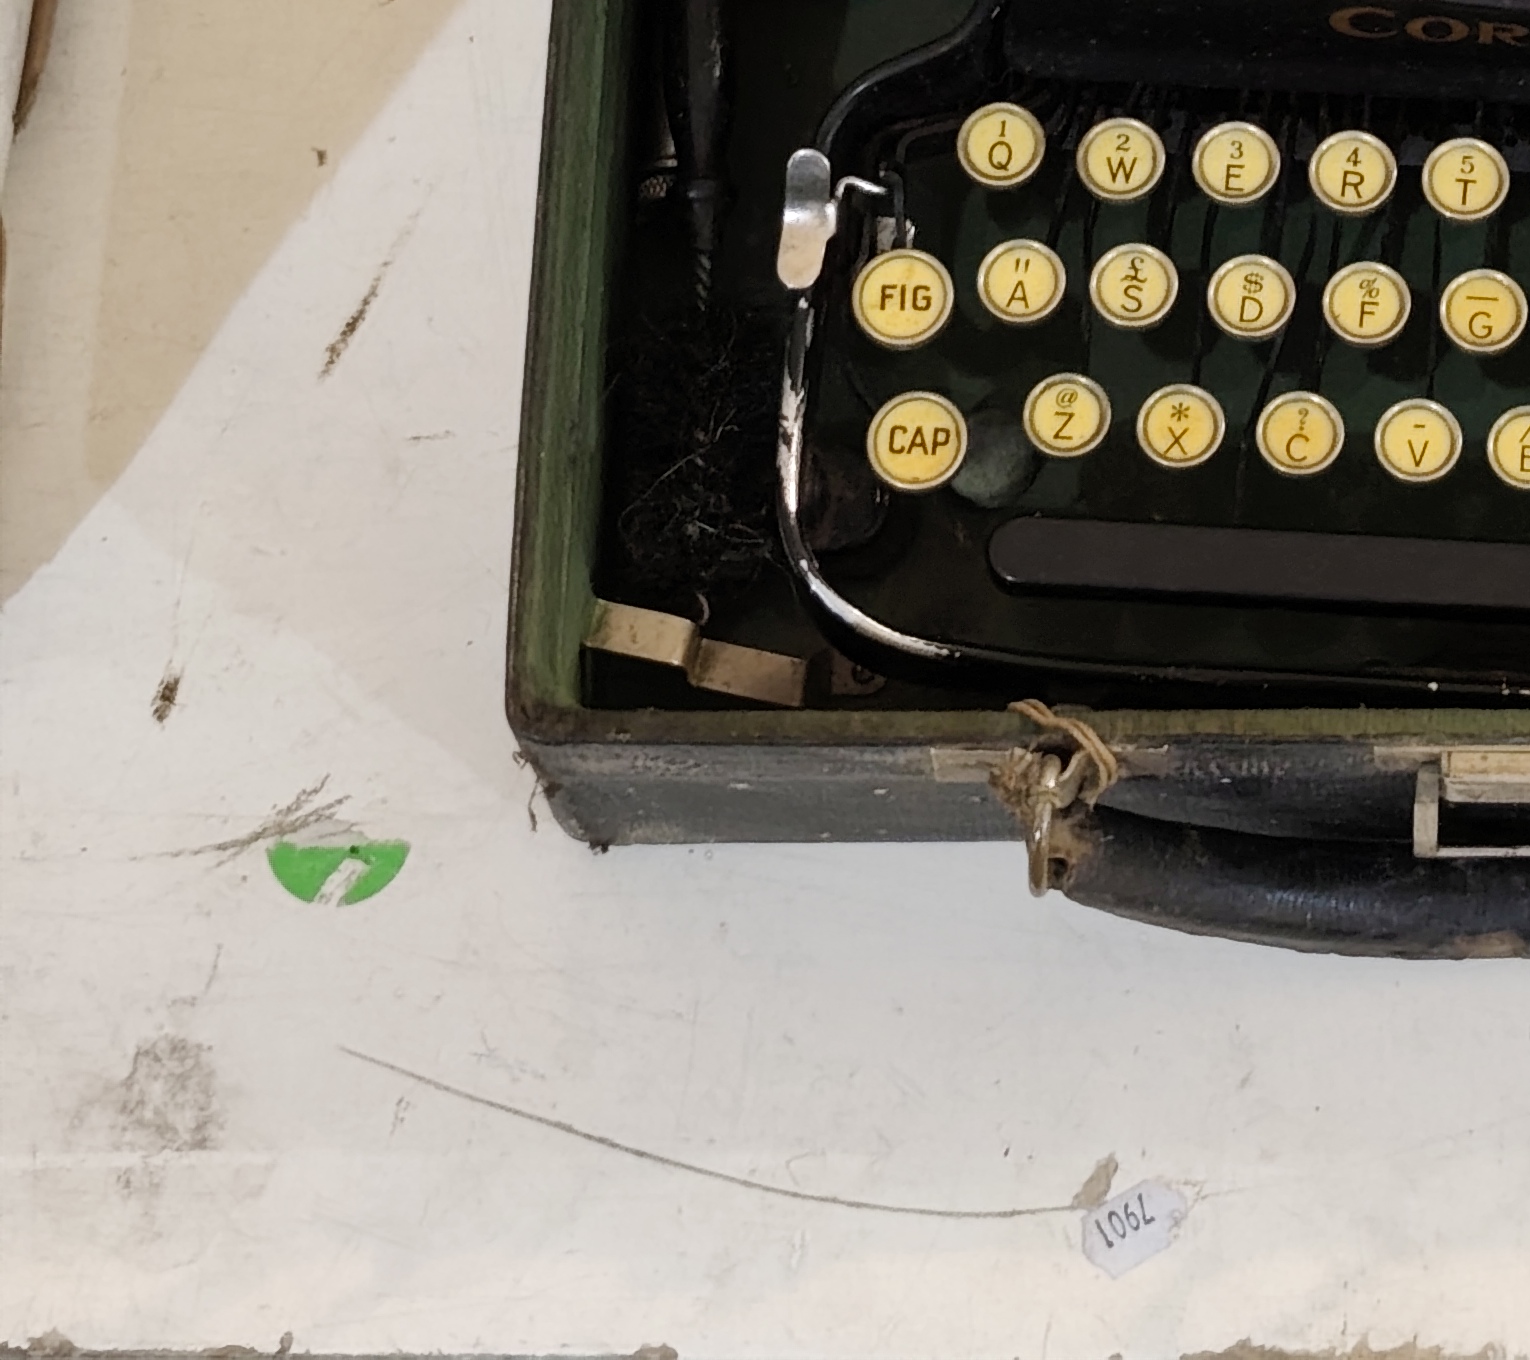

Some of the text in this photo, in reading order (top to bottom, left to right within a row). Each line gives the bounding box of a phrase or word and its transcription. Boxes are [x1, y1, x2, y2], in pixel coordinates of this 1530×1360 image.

[998, 119, 1007, 138] 1
[1115, 133, 1131, 153] 2
[988, 140, 1013, 172] Q
[1230, 140, 1244, 160] 3
[1346, 146, 1362, 167] 4
[1460, 155, 1475, 174] 5
[1106, 156, 1138, 185] W
[1224, 163, 1245, 193] E
[1340, 170, 1365, 199] R
[1455, 178, 1477, 206] T
[1121, 256, 1147, 283] £
[1242, 272, 1264, 294] $
[879, 284, 932, 312] FIG
[1005, 280, 1030, 309] A
[1120, 284, 1143, 314] S
[1358, 277, 1380, 299] %
[1238, 295, 1264, 323] D
[1358, 300, 1380, 329] F
[1468, 311, 1493, 340] G
[1055, 388, 1079, 409] @
[888, 424, 951, 456] CAP
[1052, 410, 1075, 441] Z
[1161, 426, 1189, 459] X
[1285, 433, 1310, 463] C
[1407, 439, 1429, 468] V
[1094, 1192, 1156, 1248] 7901
